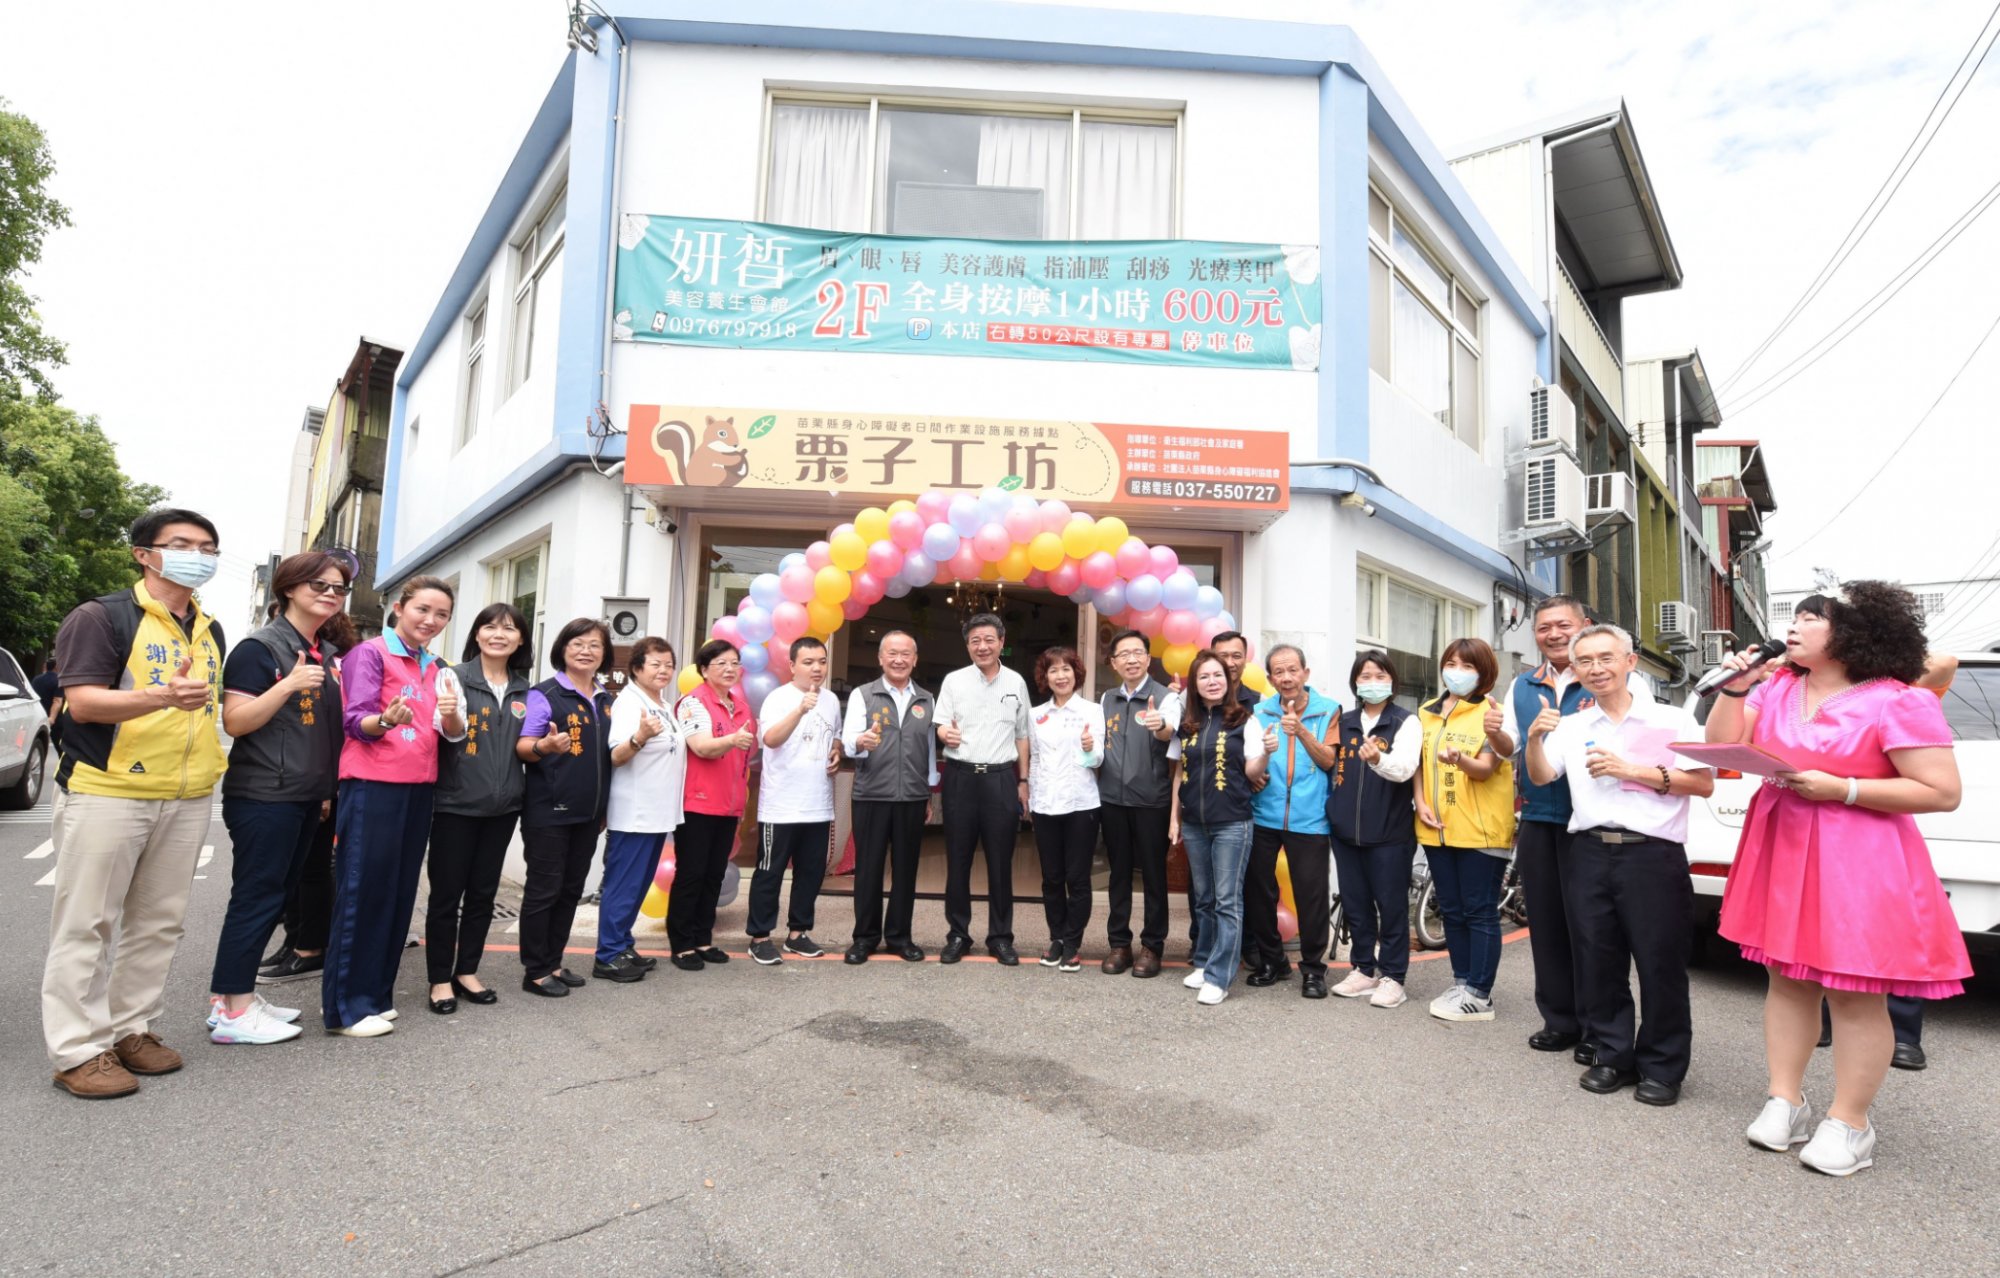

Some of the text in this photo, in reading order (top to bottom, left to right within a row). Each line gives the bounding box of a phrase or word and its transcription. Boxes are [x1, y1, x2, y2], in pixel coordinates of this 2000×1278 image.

[666, 228, 792, 290] 妍皙
[938, 253, 1027, 279] 美容護膚
[1044, 255, 1109, 280] 指油壓
[1126, 257, 1171, 281] 刮痧
[1188, 259, 1275, 284] 光療美甲
[664, 290, 790, 314] 美容養生會館
[813, 279, 1284, 339] 2F 全身按摩1小時 600元
[669, 317, 797, 338] 0976797918
[940, 321, 981, 342] 本店
[989, 325, 1168, 349] 右轉50公尺設有專屬
[1180, 331, 1255, 353] 停車位
[797, 418, 1059, 440] 苗栗縣身心障礙者日間作業設施服務據點
[795, 432, 1058, 490] 栗子工坊
[1130, 480, 1275, 501] 服務電話 037-550727
